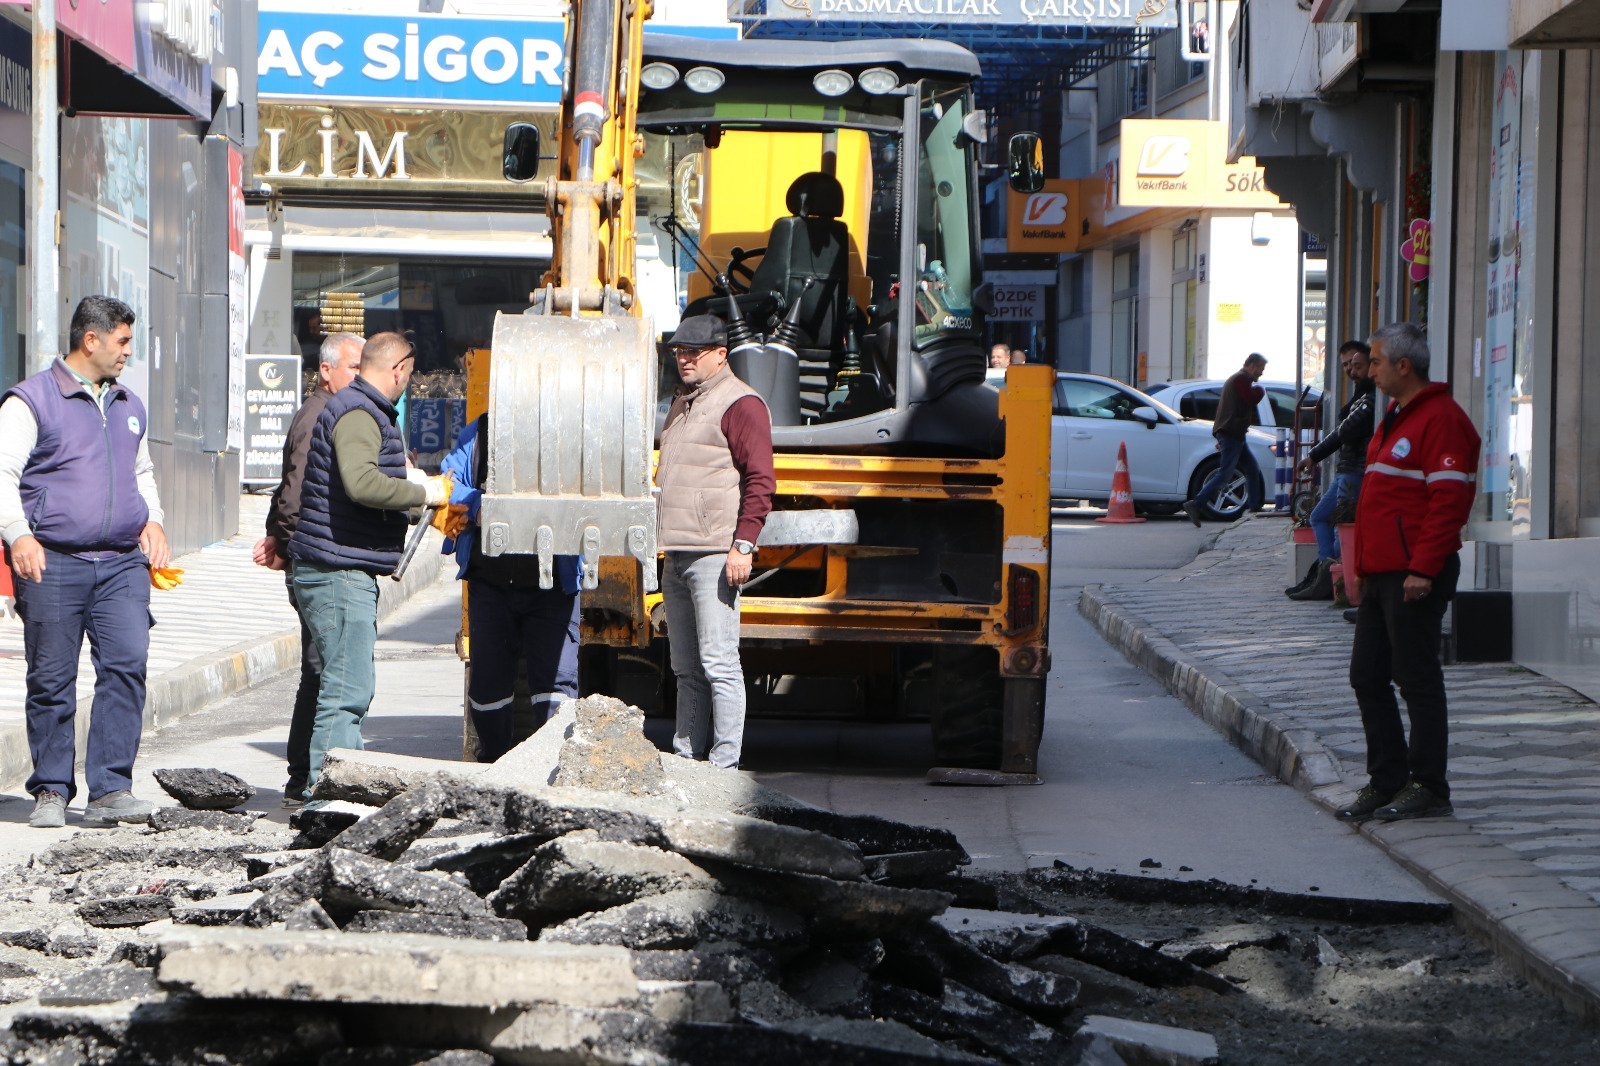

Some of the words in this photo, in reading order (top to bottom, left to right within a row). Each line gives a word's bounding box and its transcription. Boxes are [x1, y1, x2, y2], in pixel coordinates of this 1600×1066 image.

[819, 0, 1001, 15] BASMACILAR
[1020, 0, 1132, 23] ÇARŞISI
[1137, 180, 1188, 190] VakıfBank
[1022, 229, 1067, 239] VakıfBank
[993, 288, 1037, 302] ÖZDE
